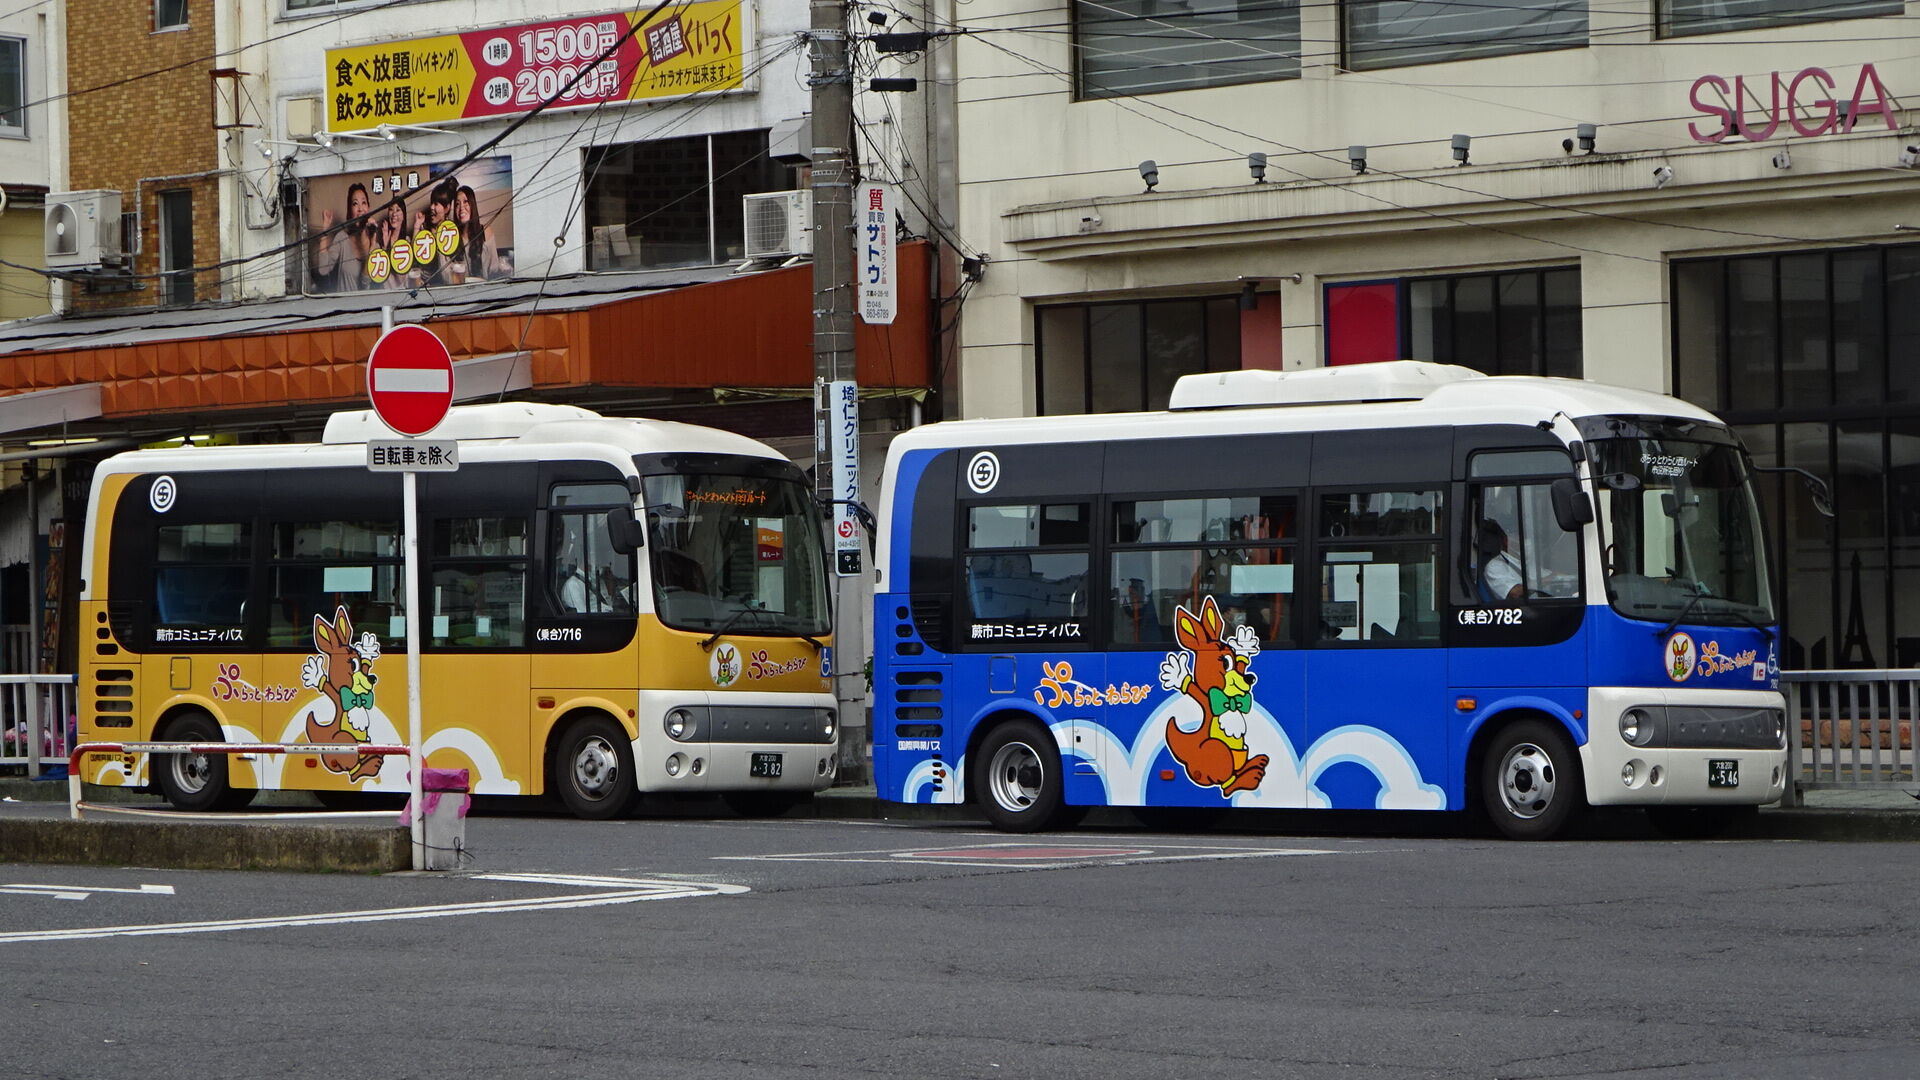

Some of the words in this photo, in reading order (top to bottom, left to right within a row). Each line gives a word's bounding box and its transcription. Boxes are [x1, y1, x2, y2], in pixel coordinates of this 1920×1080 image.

[518, 22, 619, 66] 1500円
[683, 13, 733, 58] くいっく
[488, 43, 509, 61] 1時間
[488, 82, 510, 100] 2時間
[515, 61, 619, 106] 2000円
[1688, 63, 1899, 144] SUGA
[372, 172, 420, 194] 居酒屋
[869, 188, 884, 211] 質
[868, 211, 885, 223] 買取
[371, 226, 458, 279] カラオケ
[866, 224, 880, 284] サトウ
[373, 446, 454, 465] 自転車を除く
[1458, 608, 1523, 625] (乗合)782
[156, 629, 243, 642] 蕨市コミュニティバス
[536, 628, 582, 641] (乗合)716
[971, 623, 1081, 639] 蕨市コミュニティバス
